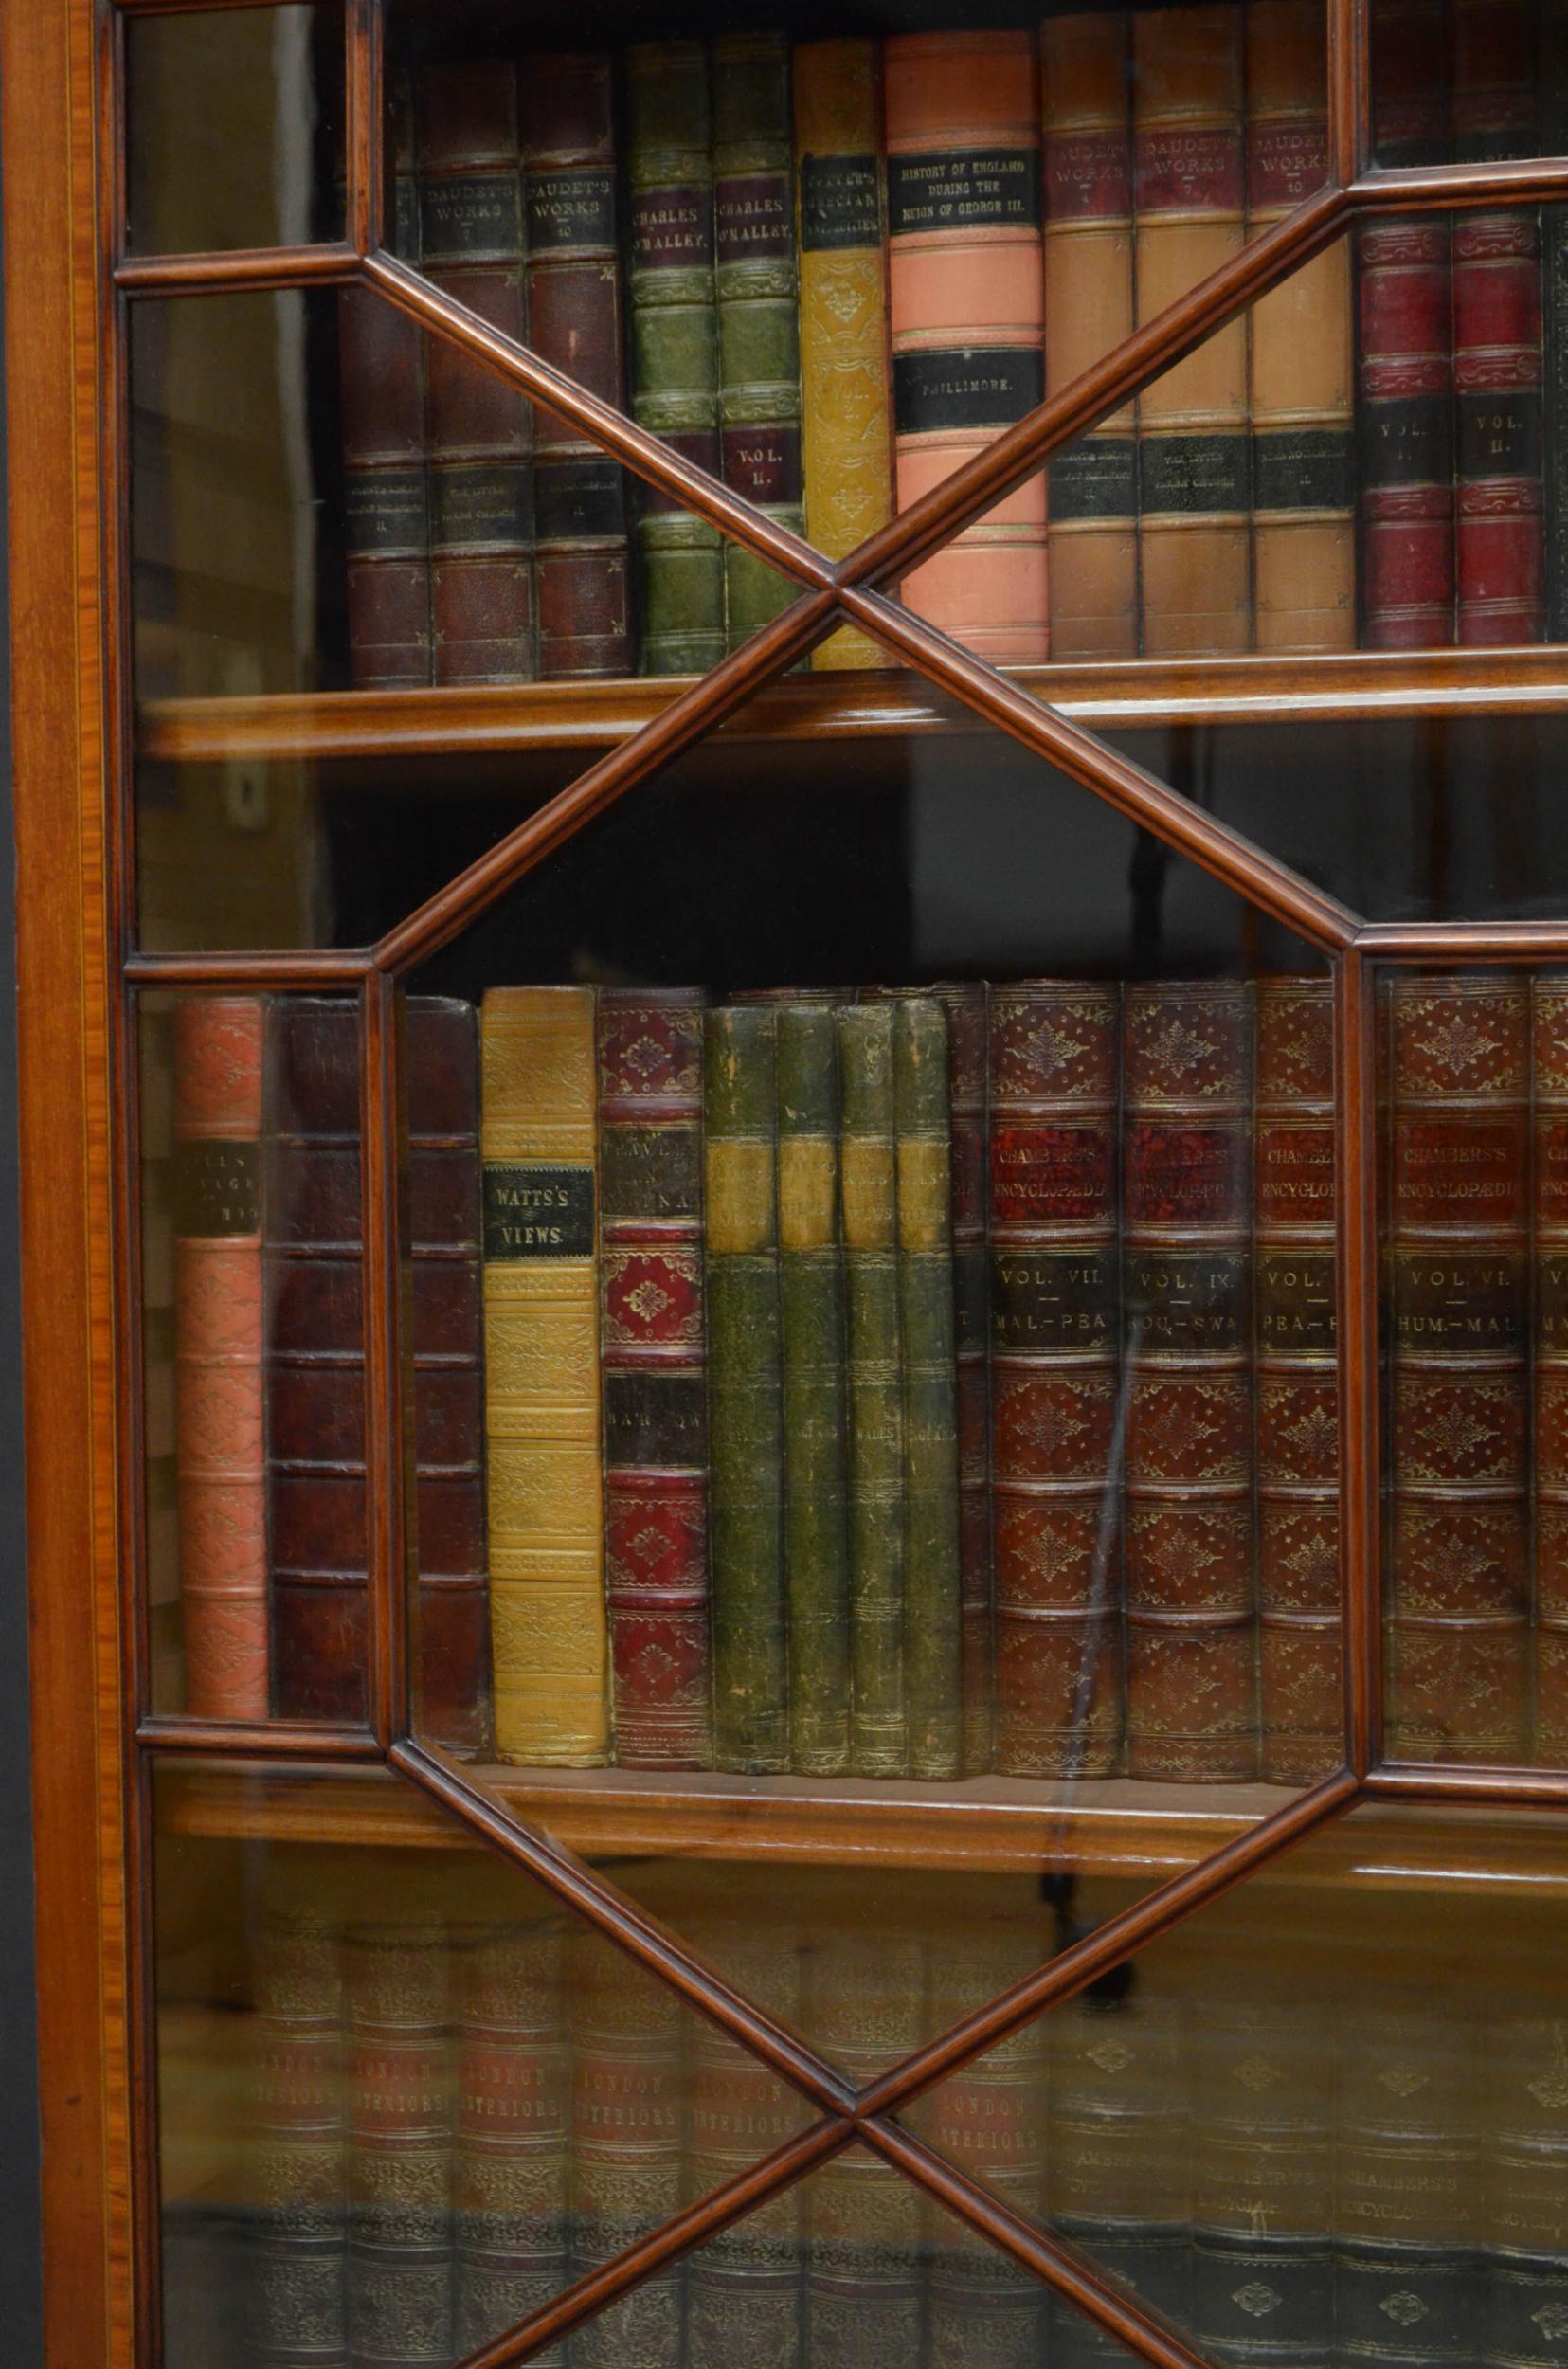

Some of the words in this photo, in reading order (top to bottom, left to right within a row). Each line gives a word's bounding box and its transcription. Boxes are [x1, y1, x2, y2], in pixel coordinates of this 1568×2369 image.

[902, 165, 946, 181] HISTORY
[952, 162, 966, 175] OF
[972, 159, 1025, 173] ENGLAND
[928, 182, 970, 196] DURING
[976, 180, 1000, 193] THE
[533, 200, 600, 219] WORKS
[719, 199, 784, 216] CHARLES
[903, 206, 934, 221] REIGN
[940, 204, 952, 216] OF
[958, 200, 1001, 214] GEORGE
[1476, 415, 1523, 430] VOL.
[737, 449, 783, 463] VOL.
[496, 1185, 569, 1207] WATTS'S
[501, 1227, 564, 1244] VIEWS.
[1000, 1270, 1053, 1285] VOL.
[1140, 1274, 1195, 1290] VOL.
[1266, 1272, 1322, 1287] VOL.
[1411, 1272, 1469, 1287] VOL.
